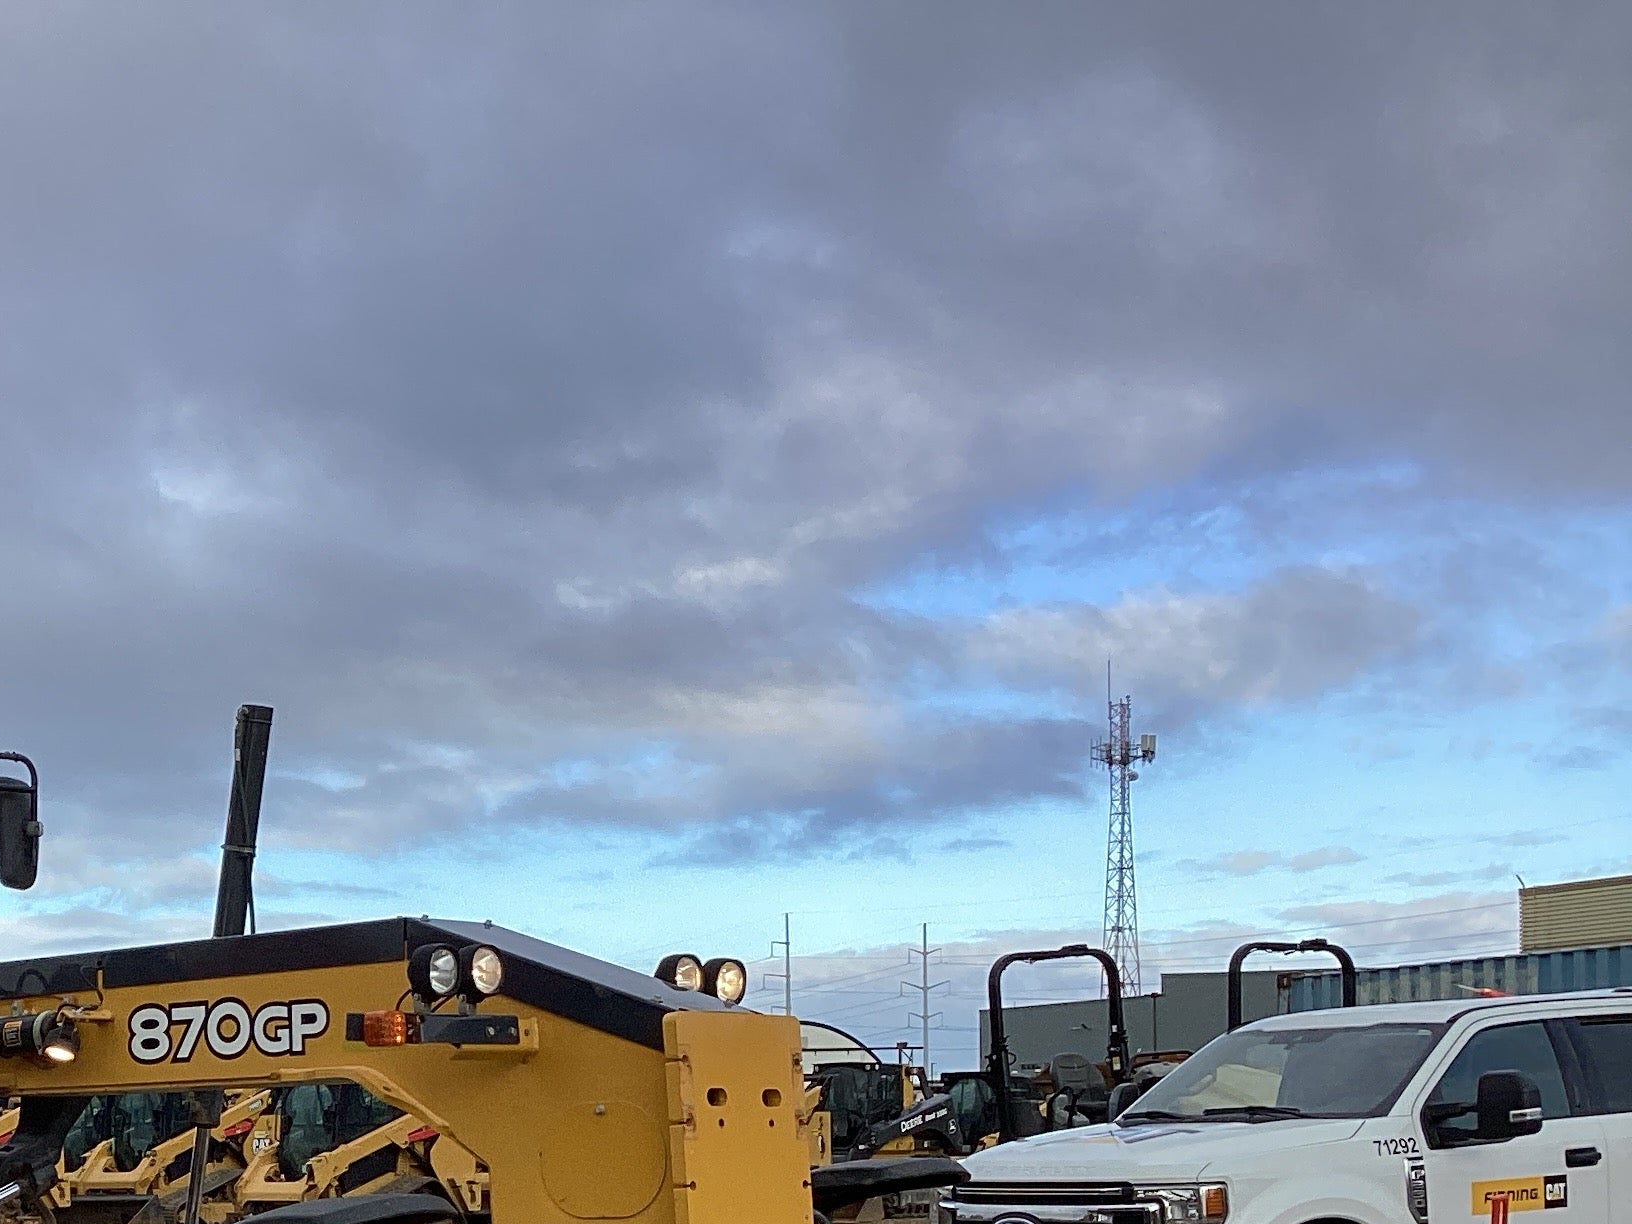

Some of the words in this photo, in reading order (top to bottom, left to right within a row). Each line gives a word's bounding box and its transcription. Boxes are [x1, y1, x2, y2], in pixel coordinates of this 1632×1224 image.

[129, 999, 329, 1063] 870GP
[901, 1114, 923, 1132] DEERE
[1373, 1137, 1420, 1156] 71292
[1484, 1188, 1539, 1204] FNING
[1546, 1182, 1566, 1201] CAT
